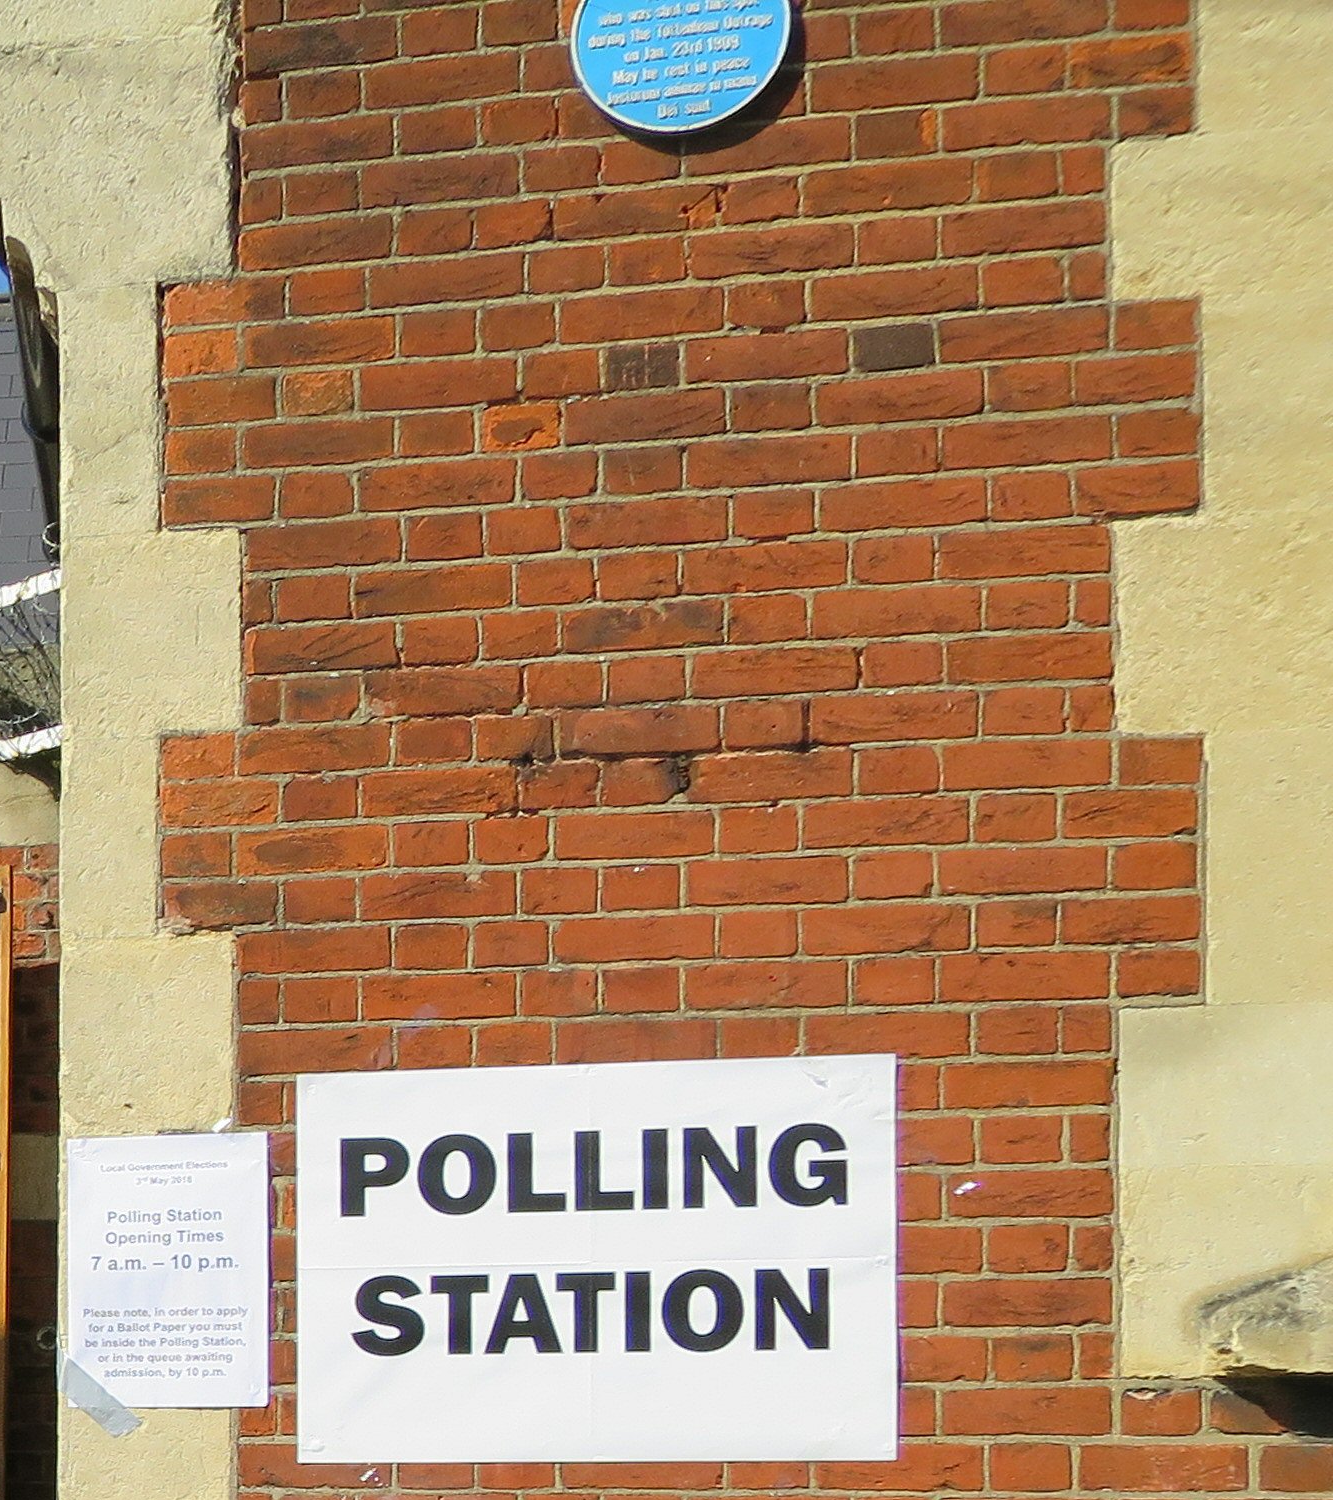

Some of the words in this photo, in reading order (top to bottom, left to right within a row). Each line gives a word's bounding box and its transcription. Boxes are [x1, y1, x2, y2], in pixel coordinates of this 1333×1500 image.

[612, 68, 639, 86] May
[100, 1164, 124, 1172] Local
[339, 1123, 849, 1217] POLLING
[107, 1209, 161, 1225] Polling
[166, 1208, 222, 1221] Station
[105, 1231, 171, 1247] Opening
[176, 1229, 224, 1242] Times
[91, 1256, 101, 1270] 7
[107, 1258, 146, 1271] a.m.
[170, 1254, 192, 1270] 10
[197, 1256, 239, 1272] p.m.
[83, 1308, 120, 1317] Please
[154, 1307, 165, 1317] in
[167, 1306, 199, 1316] order
[201, 1307, 213, 1316] to
[216, 1306, 248, 1318] apply
[350, 1268, 831, 1356] STATION
[88, 1323, 105, 1332] for
[117, 1322, 151, 1332] Ballot
[153, 1322, 186, 1334] Paper
[188, 1324, 210, 1334] you
[213, 1322, 243, 1331] must
[84, 1338, 98, 1348] be
[101, 1338, 135, 1348] inside
[138, 1337, 156, 1347] the
[159, 1337, 199, 1349] Polling
[97, 1355, 109, 1363] or
[112, 1353, 123, 1362] in
[126, 1352, 144, 1362] the
[146, 1355, 183, 1365] queue
[168, 1368, 183, 1379] by
